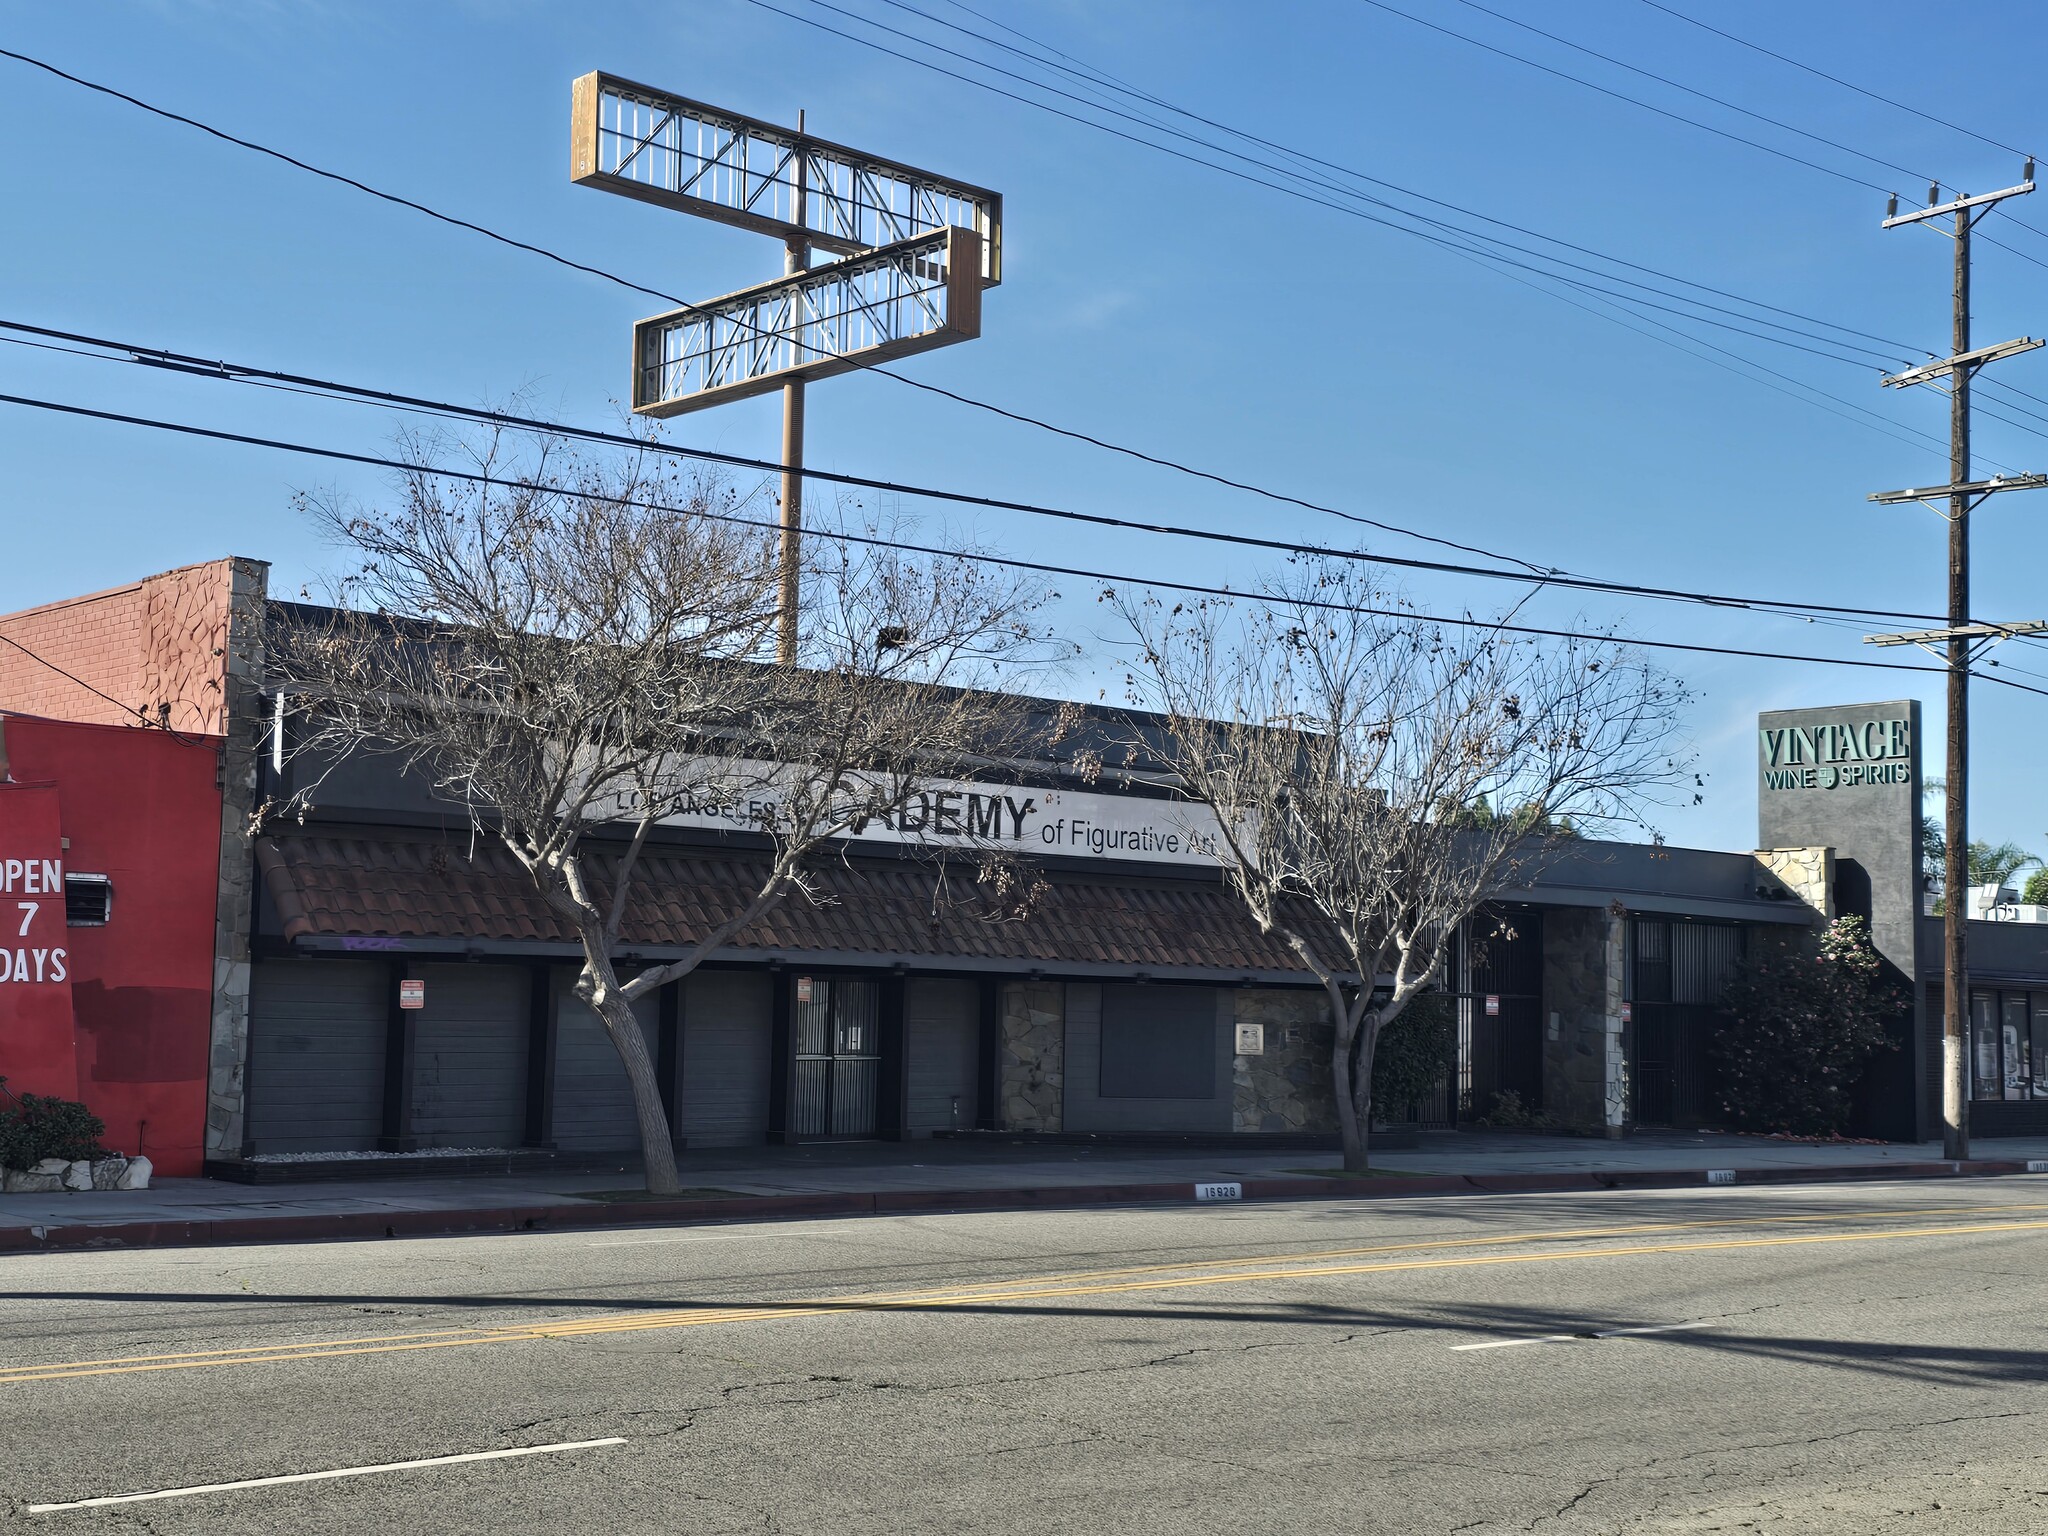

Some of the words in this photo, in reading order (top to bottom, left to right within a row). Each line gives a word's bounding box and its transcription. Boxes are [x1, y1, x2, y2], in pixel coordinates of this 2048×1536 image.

[1760, 719, 1909, 767] VINTAGE
[1763, 767, 1817, 790] WINE
[1841, 762, 1910, 787] SPIRITS
[1041, 819, 1064, 844] of
[1071, 820, 1179, 854] Figurative
[0, 859, 61, 893] PEN
[18, 902, 39, 936] 7
